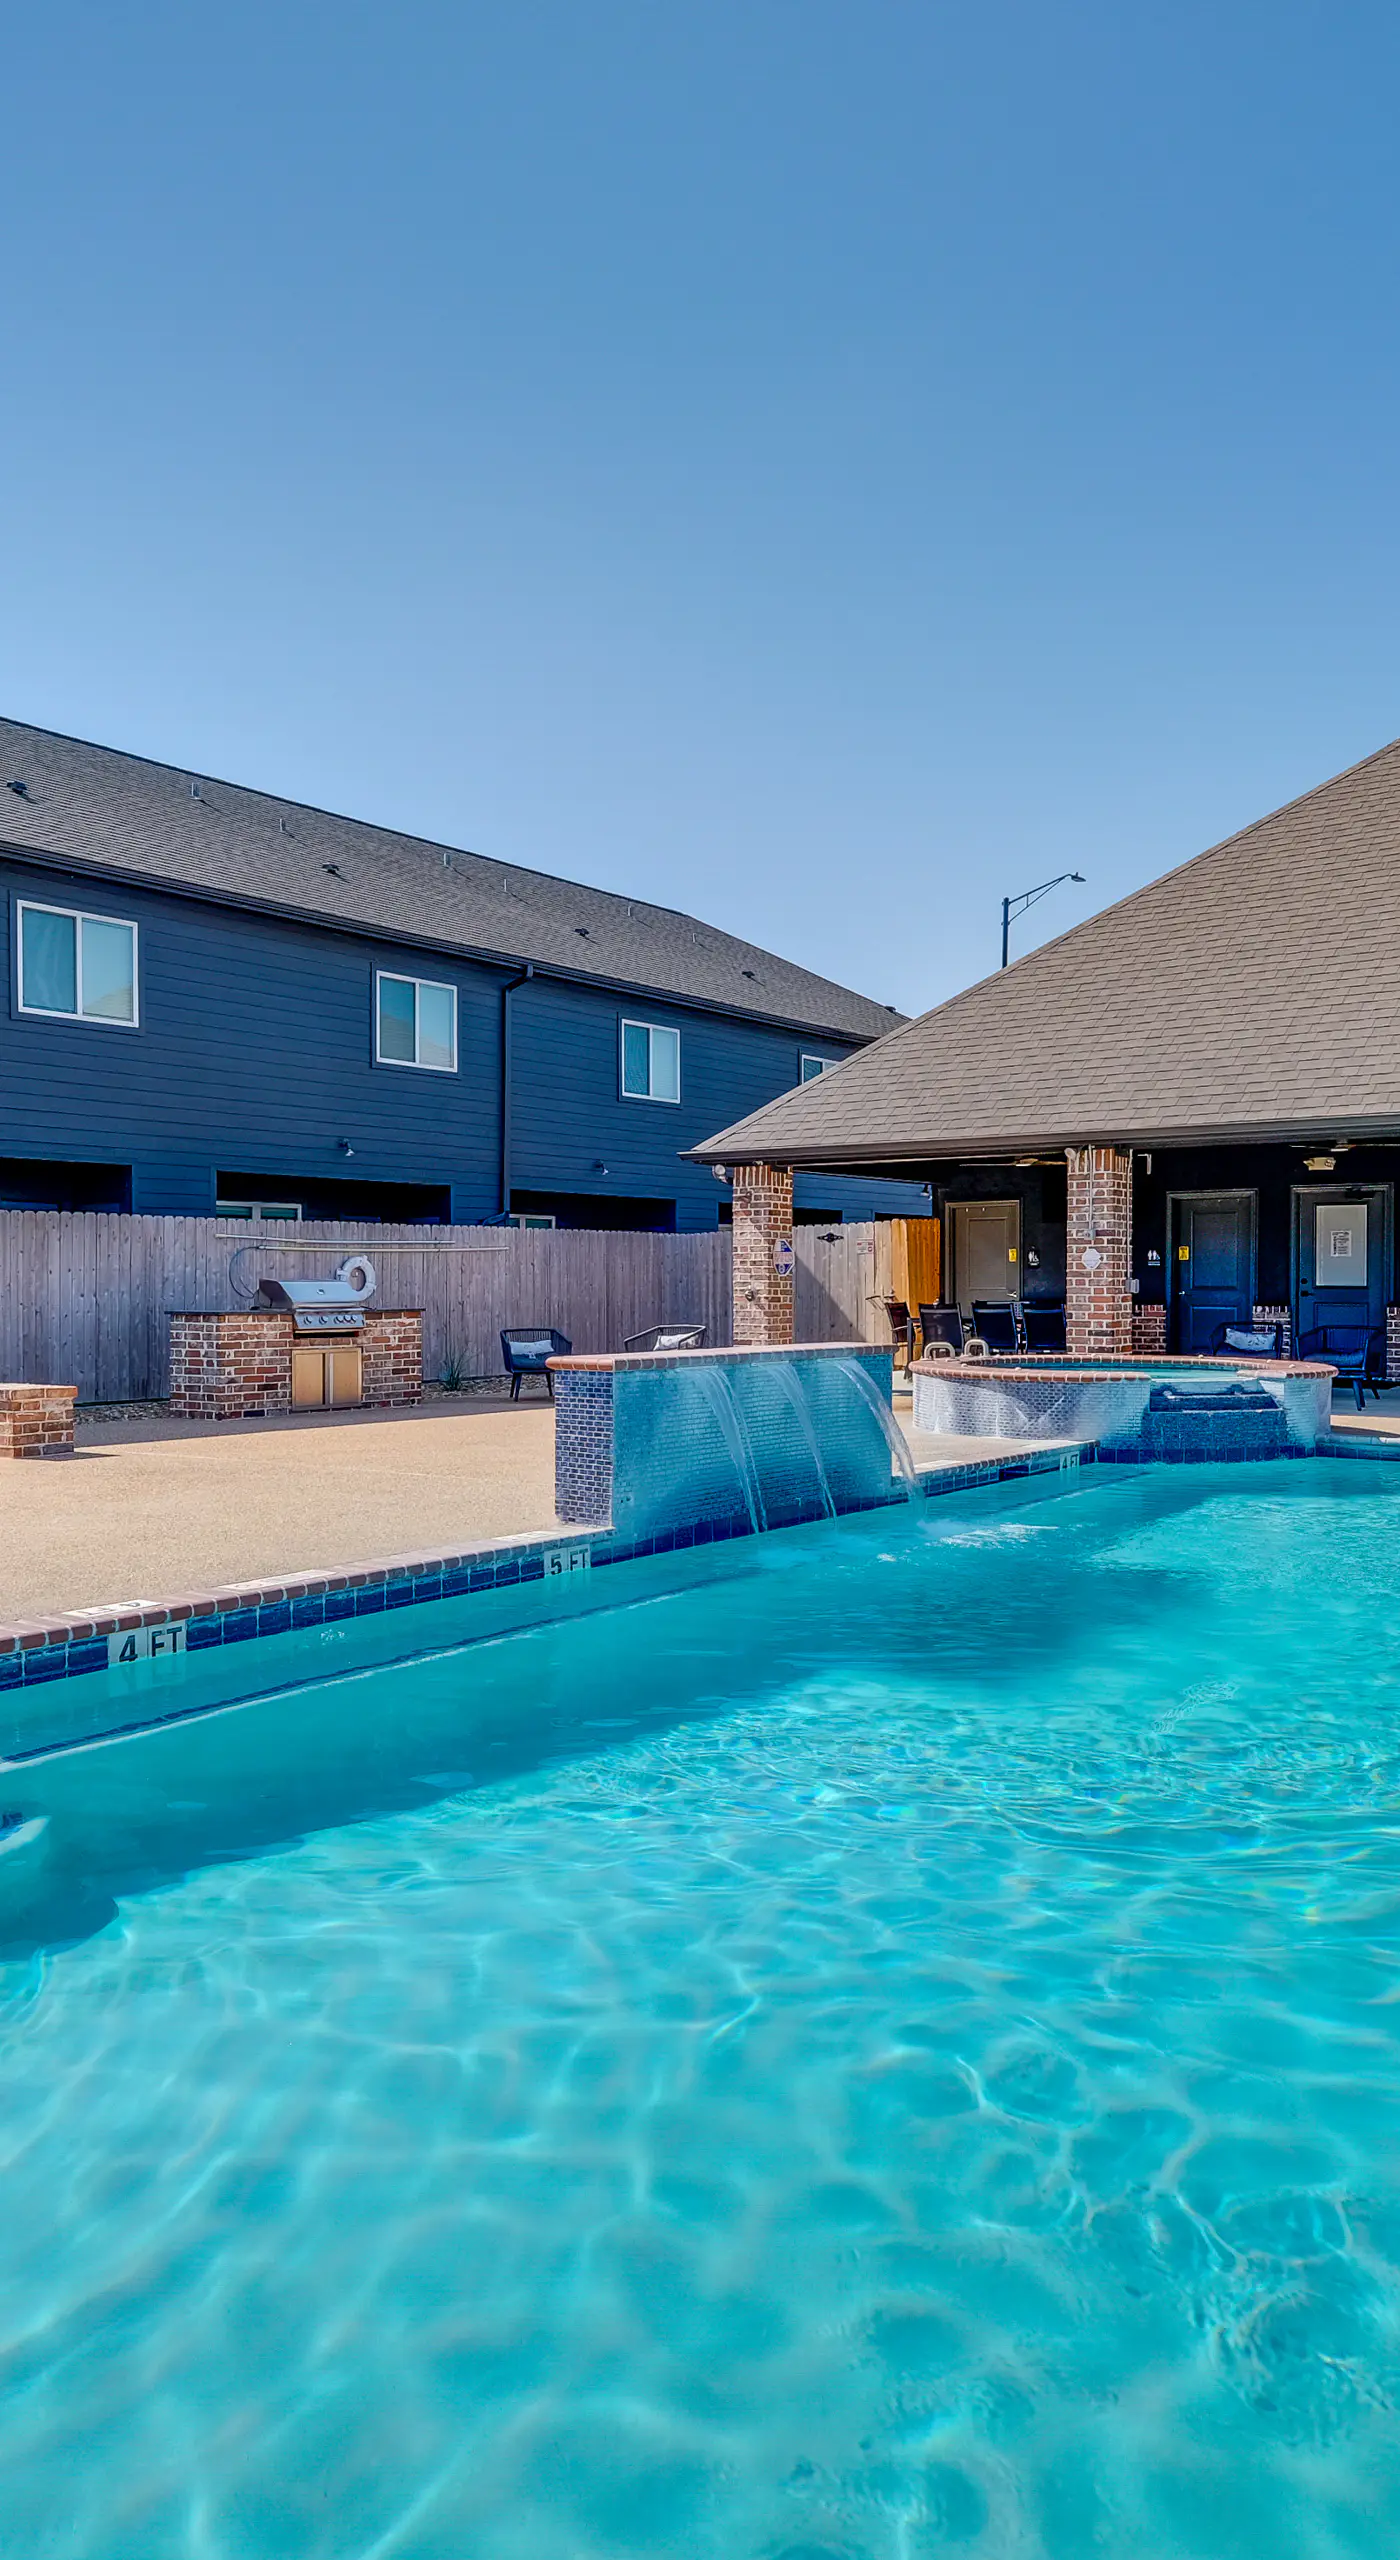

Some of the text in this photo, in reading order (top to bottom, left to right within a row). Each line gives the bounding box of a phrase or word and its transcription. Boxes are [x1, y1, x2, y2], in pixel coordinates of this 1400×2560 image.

[1070, 1453, 1079, 1468] FT
[550, 1548, 588, 1575] 5 FT
[119, 1625, 183, 1662] 4 FT
